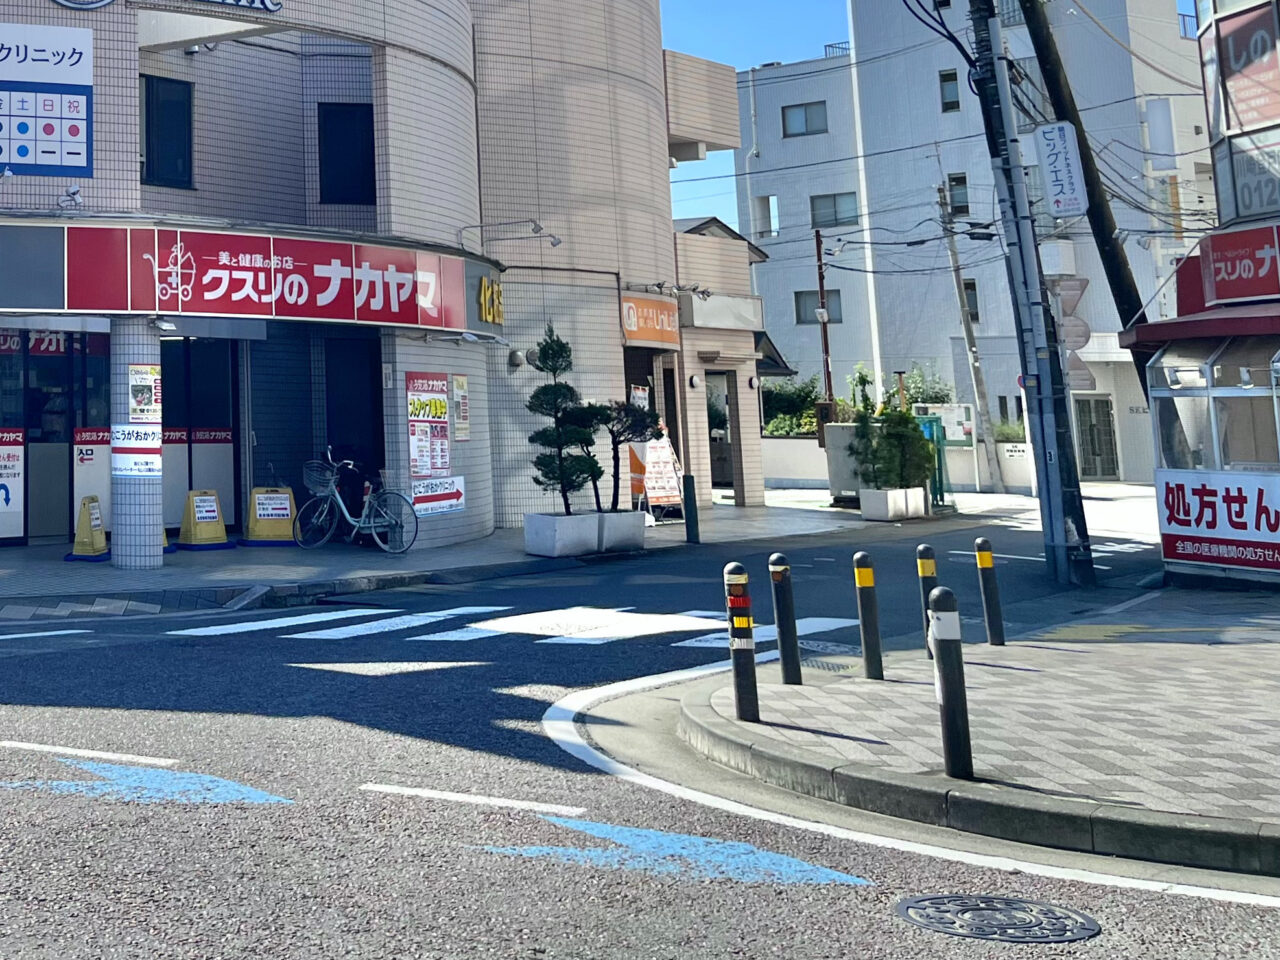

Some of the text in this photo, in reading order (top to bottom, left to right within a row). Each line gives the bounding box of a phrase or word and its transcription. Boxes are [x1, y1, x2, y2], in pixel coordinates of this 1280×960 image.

[17, 99, 29, 112] 土
[43, 99, 55, 113] 日
[1042, 126, 1066, 197] ビッグ・エス
[1241, 178, 1280, 211] 012
[218, 251, 294, 270] 美と健康のお店
[78, 448, 93, 456] 入口
[1164, 481, 1280, 533] 処方せん
